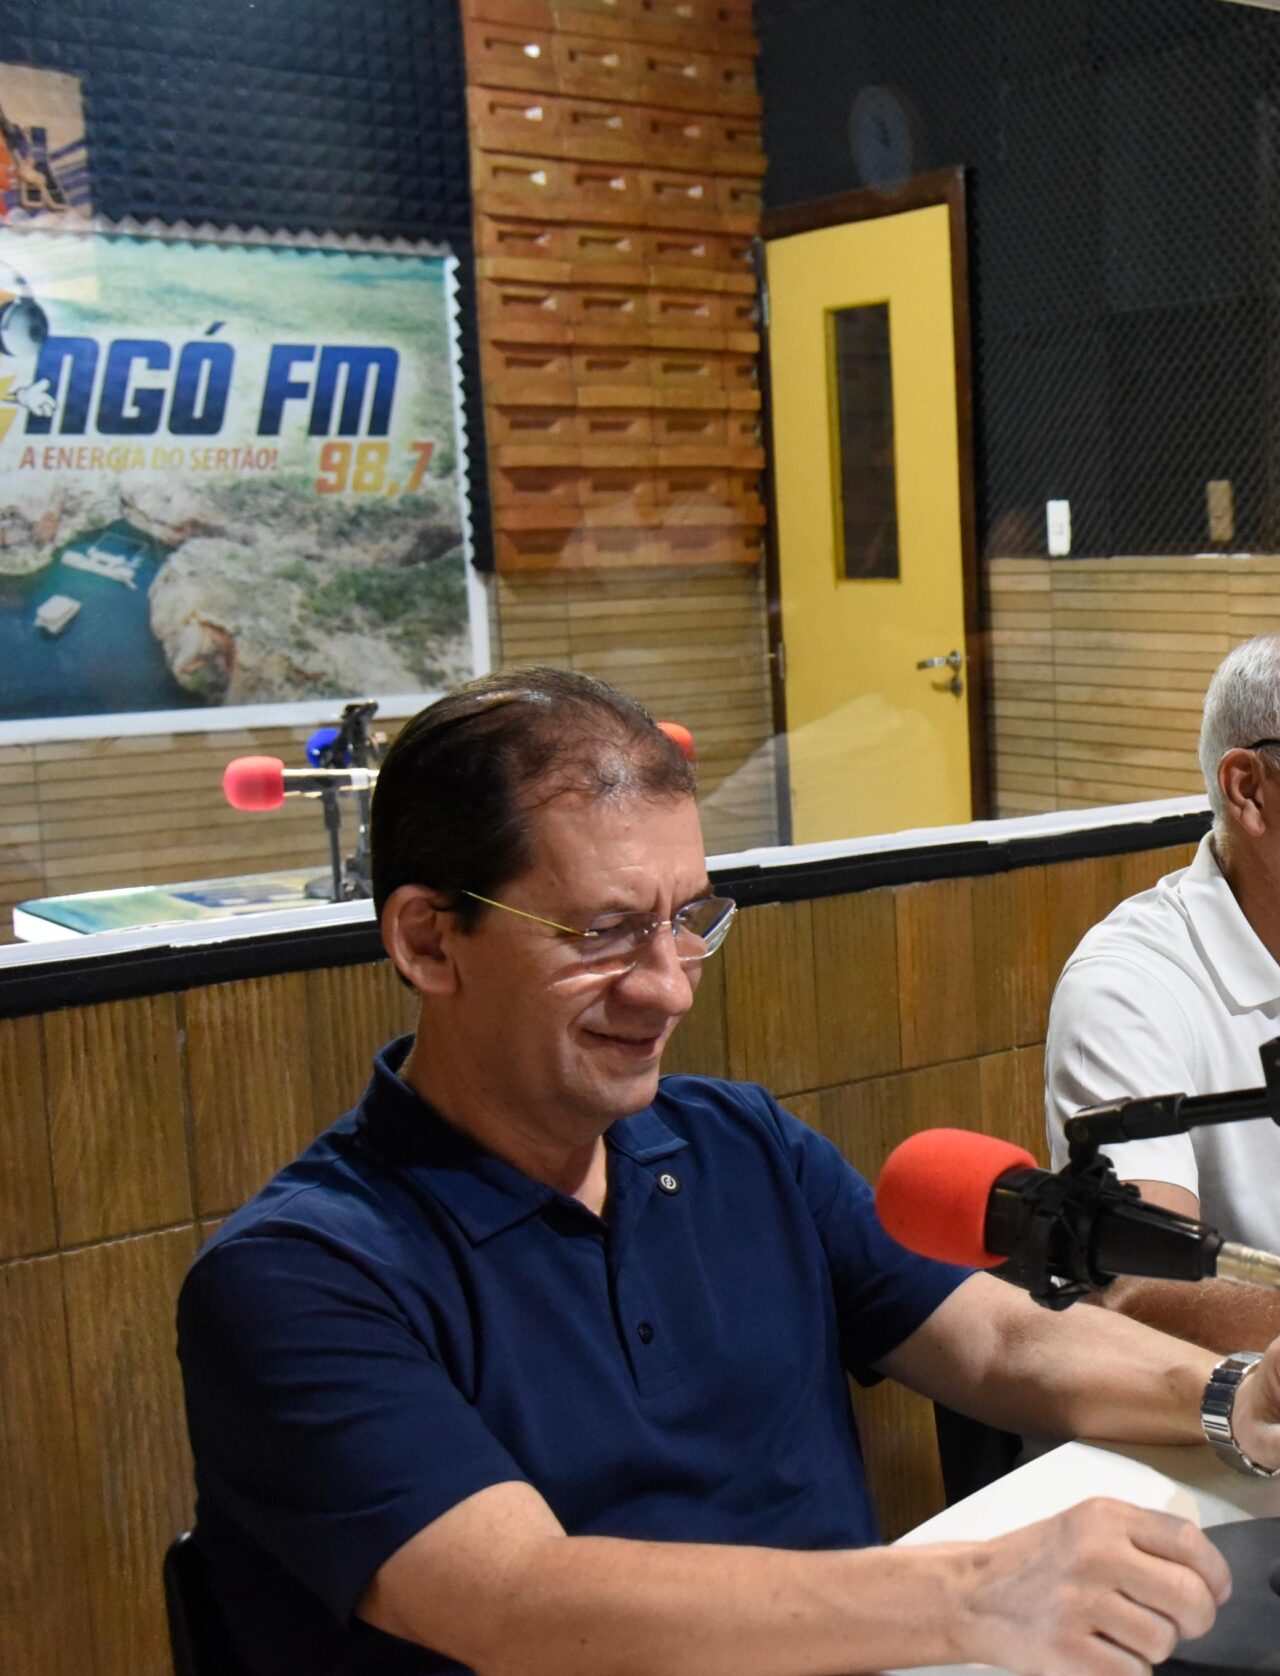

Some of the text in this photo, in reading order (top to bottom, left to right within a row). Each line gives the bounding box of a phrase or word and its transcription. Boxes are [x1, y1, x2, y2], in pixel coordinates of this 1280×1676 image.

[257, 344, 399, 437] FM
[19, 445, 279, 470] A ENERGIA DO SERTÃO!
[315, 441, 434, 497] 98,7
